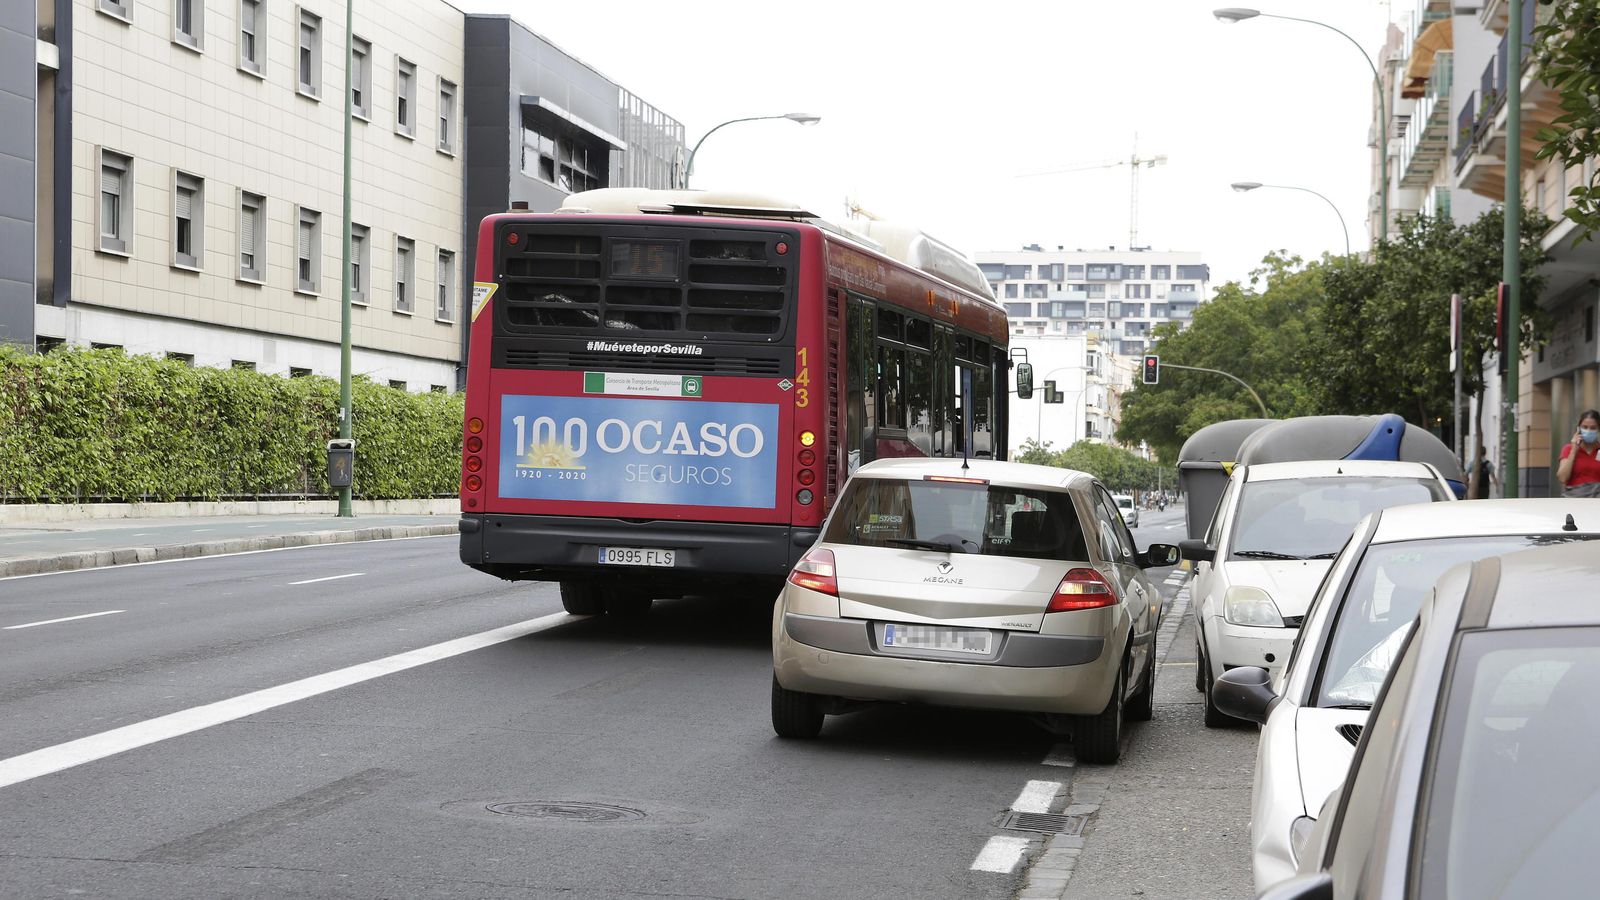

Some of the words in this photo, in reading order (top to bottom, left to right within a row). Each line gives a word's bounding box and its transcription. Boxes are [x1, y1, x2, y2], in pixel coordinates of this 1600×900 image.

[586, 341, 703, 355] #MuéveteporSevilla
[796, 346, 810, 408] 143
[512, 415, 588, 458] 100
[596, 418, 764, 458] OCASO
[515, 469, 542, 479] 1920
[559, 471, 587, 480] 2020
[625, 463, 732, 486] SEGUROS
[608, 549, 642, 563] 0995
[646, 551, 673, 565] FLS
